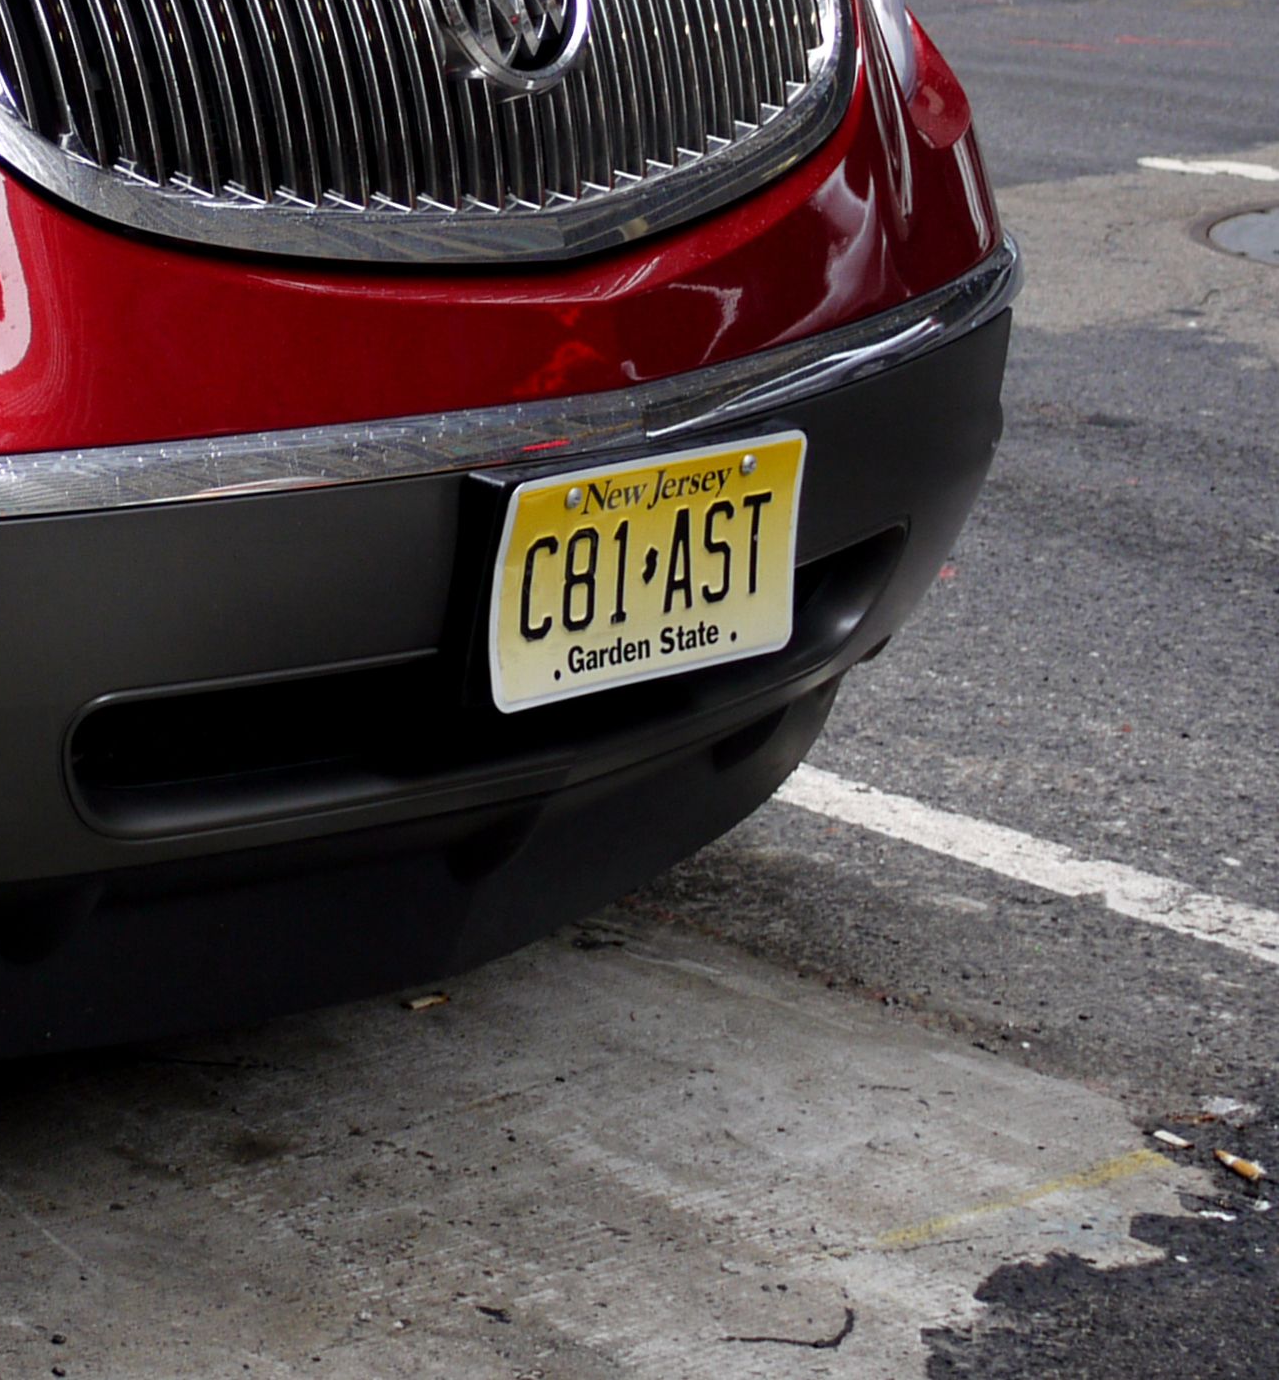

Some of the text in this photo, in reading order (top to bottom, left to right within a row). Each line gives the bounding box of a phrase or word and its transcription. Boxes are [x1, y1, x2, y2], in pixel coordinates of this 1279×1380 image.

[580, 466, 733, 516] New Jersey
[567, 621, 719, 675] Garden State
